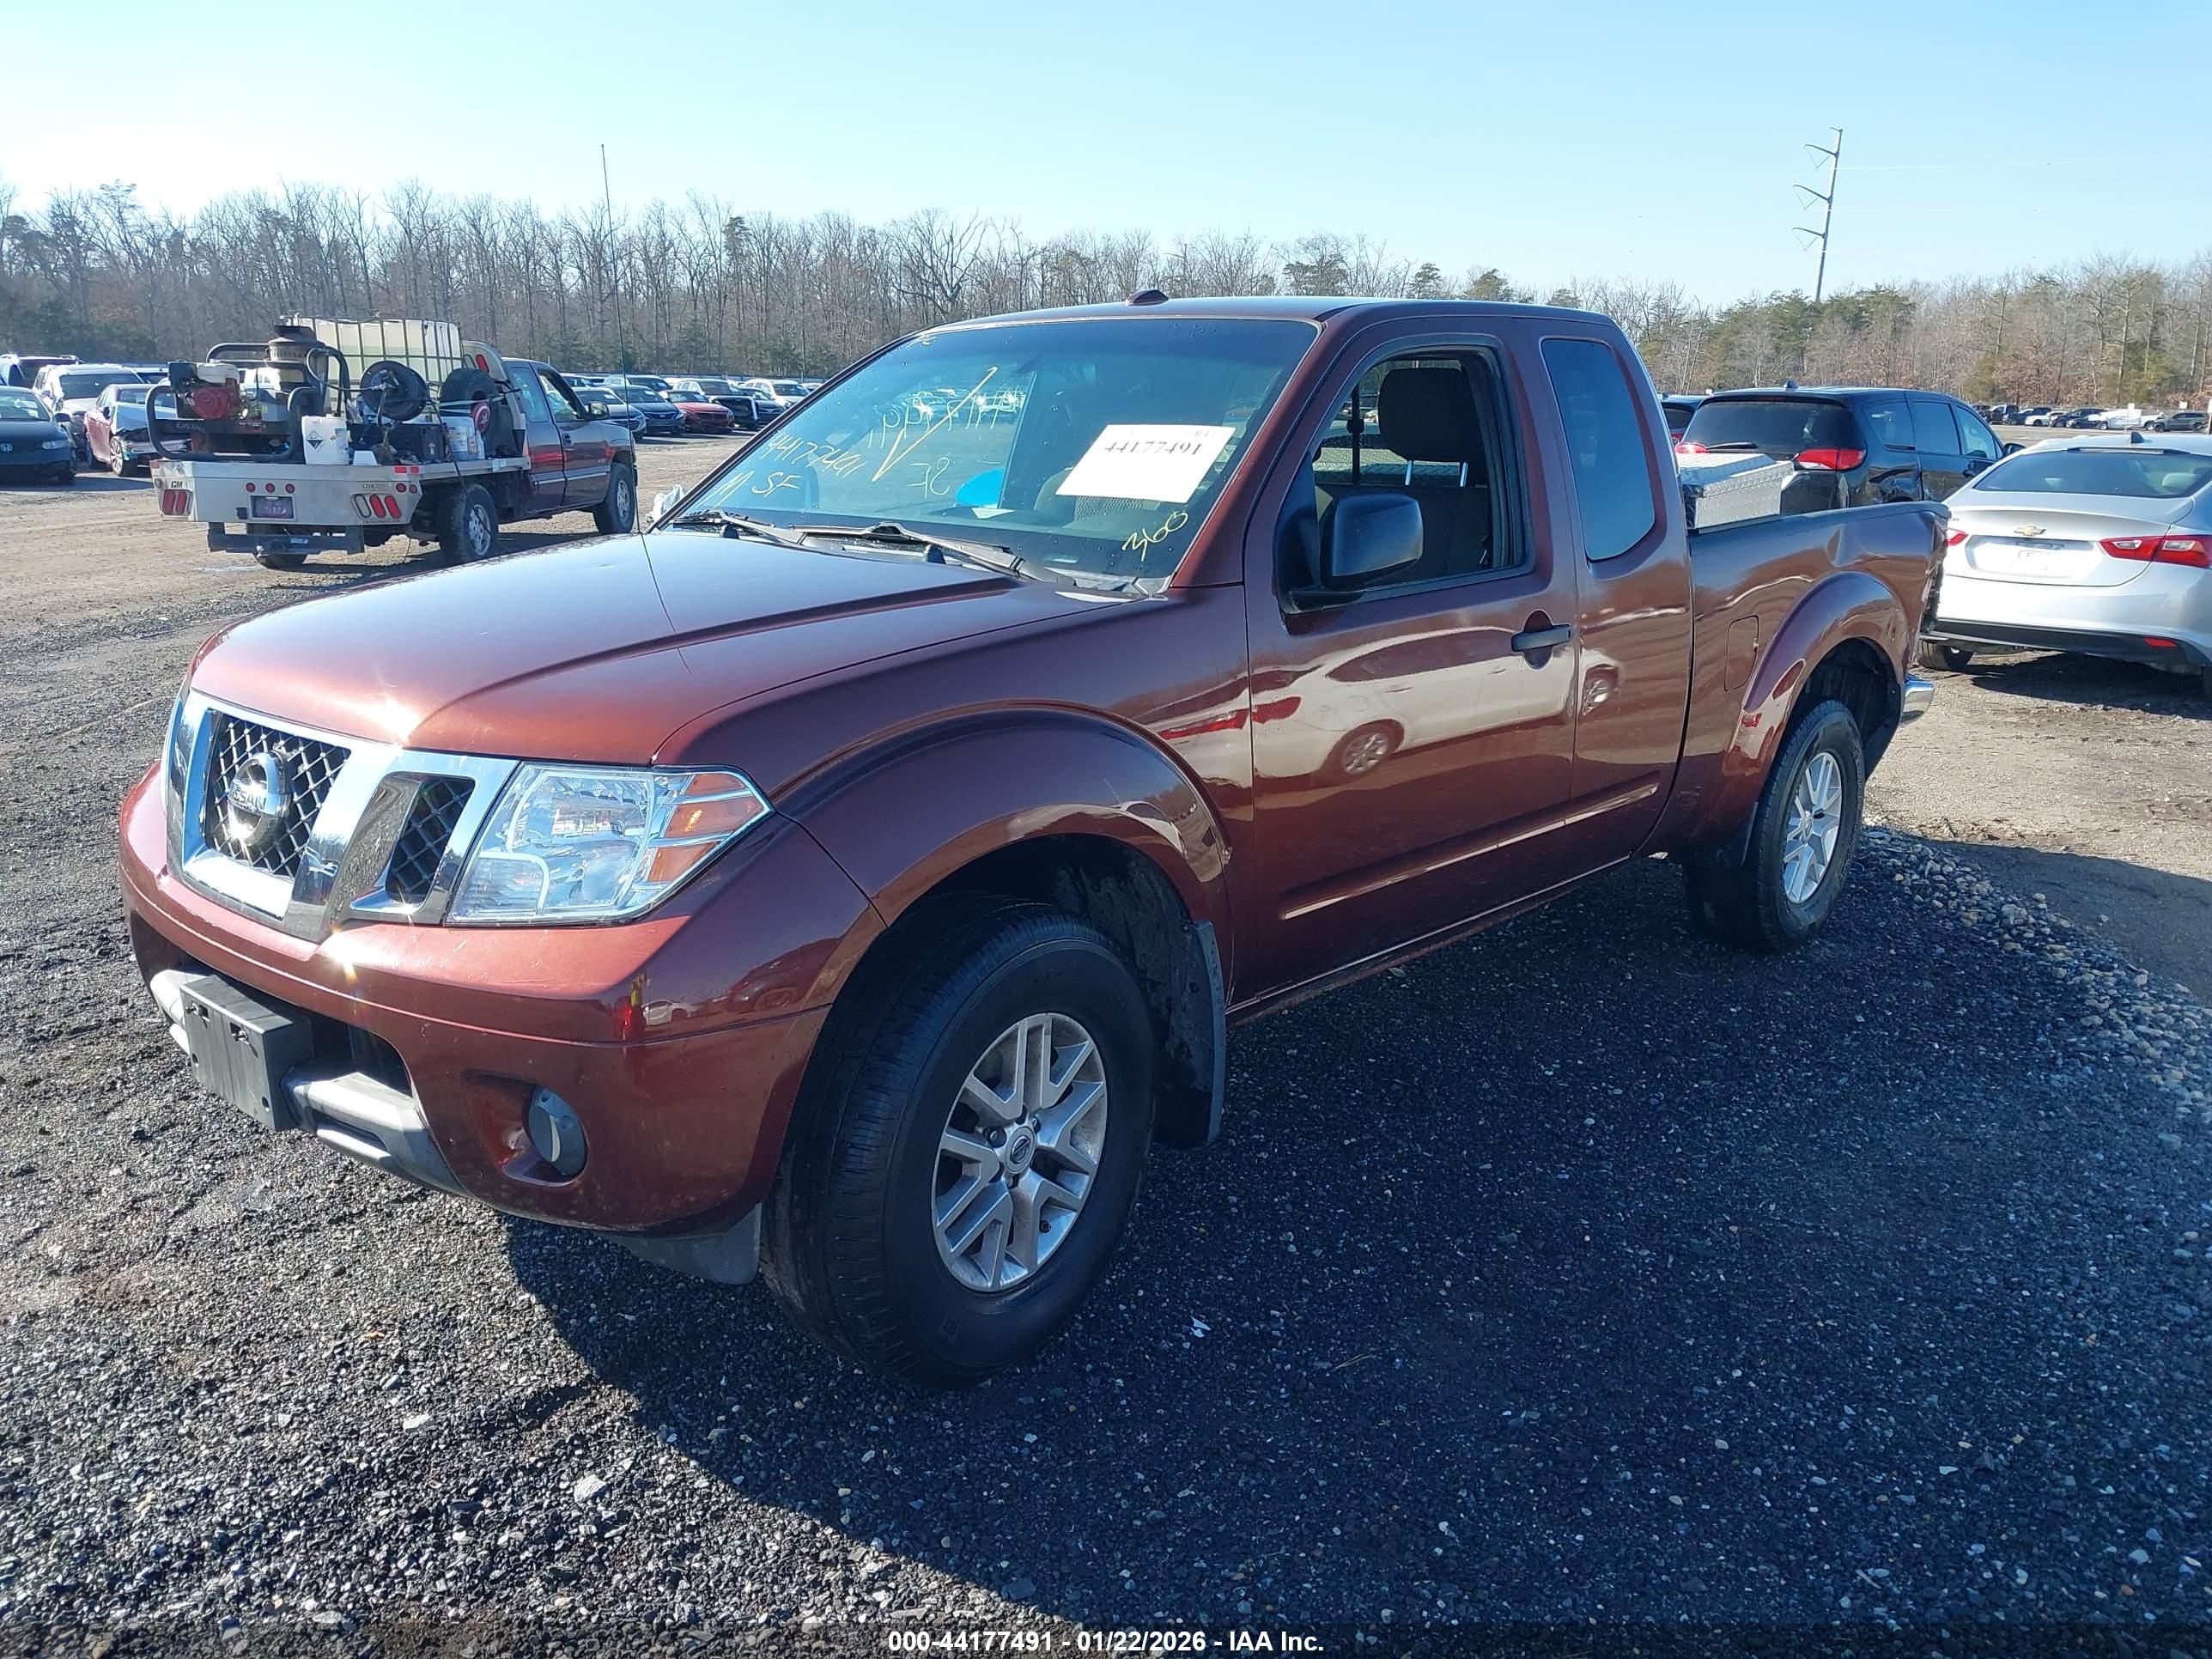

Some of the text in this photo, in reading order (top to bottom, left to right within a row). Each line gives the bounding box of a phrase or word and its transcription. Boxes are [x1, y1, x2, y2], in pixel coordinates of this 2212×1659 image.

[1103, 441, 1202, 456] 44177491
[750, 471, 805, 498] SF
[1121, 510, 1189, 562] 360
[228, 785, 267, 811] ISSAN
